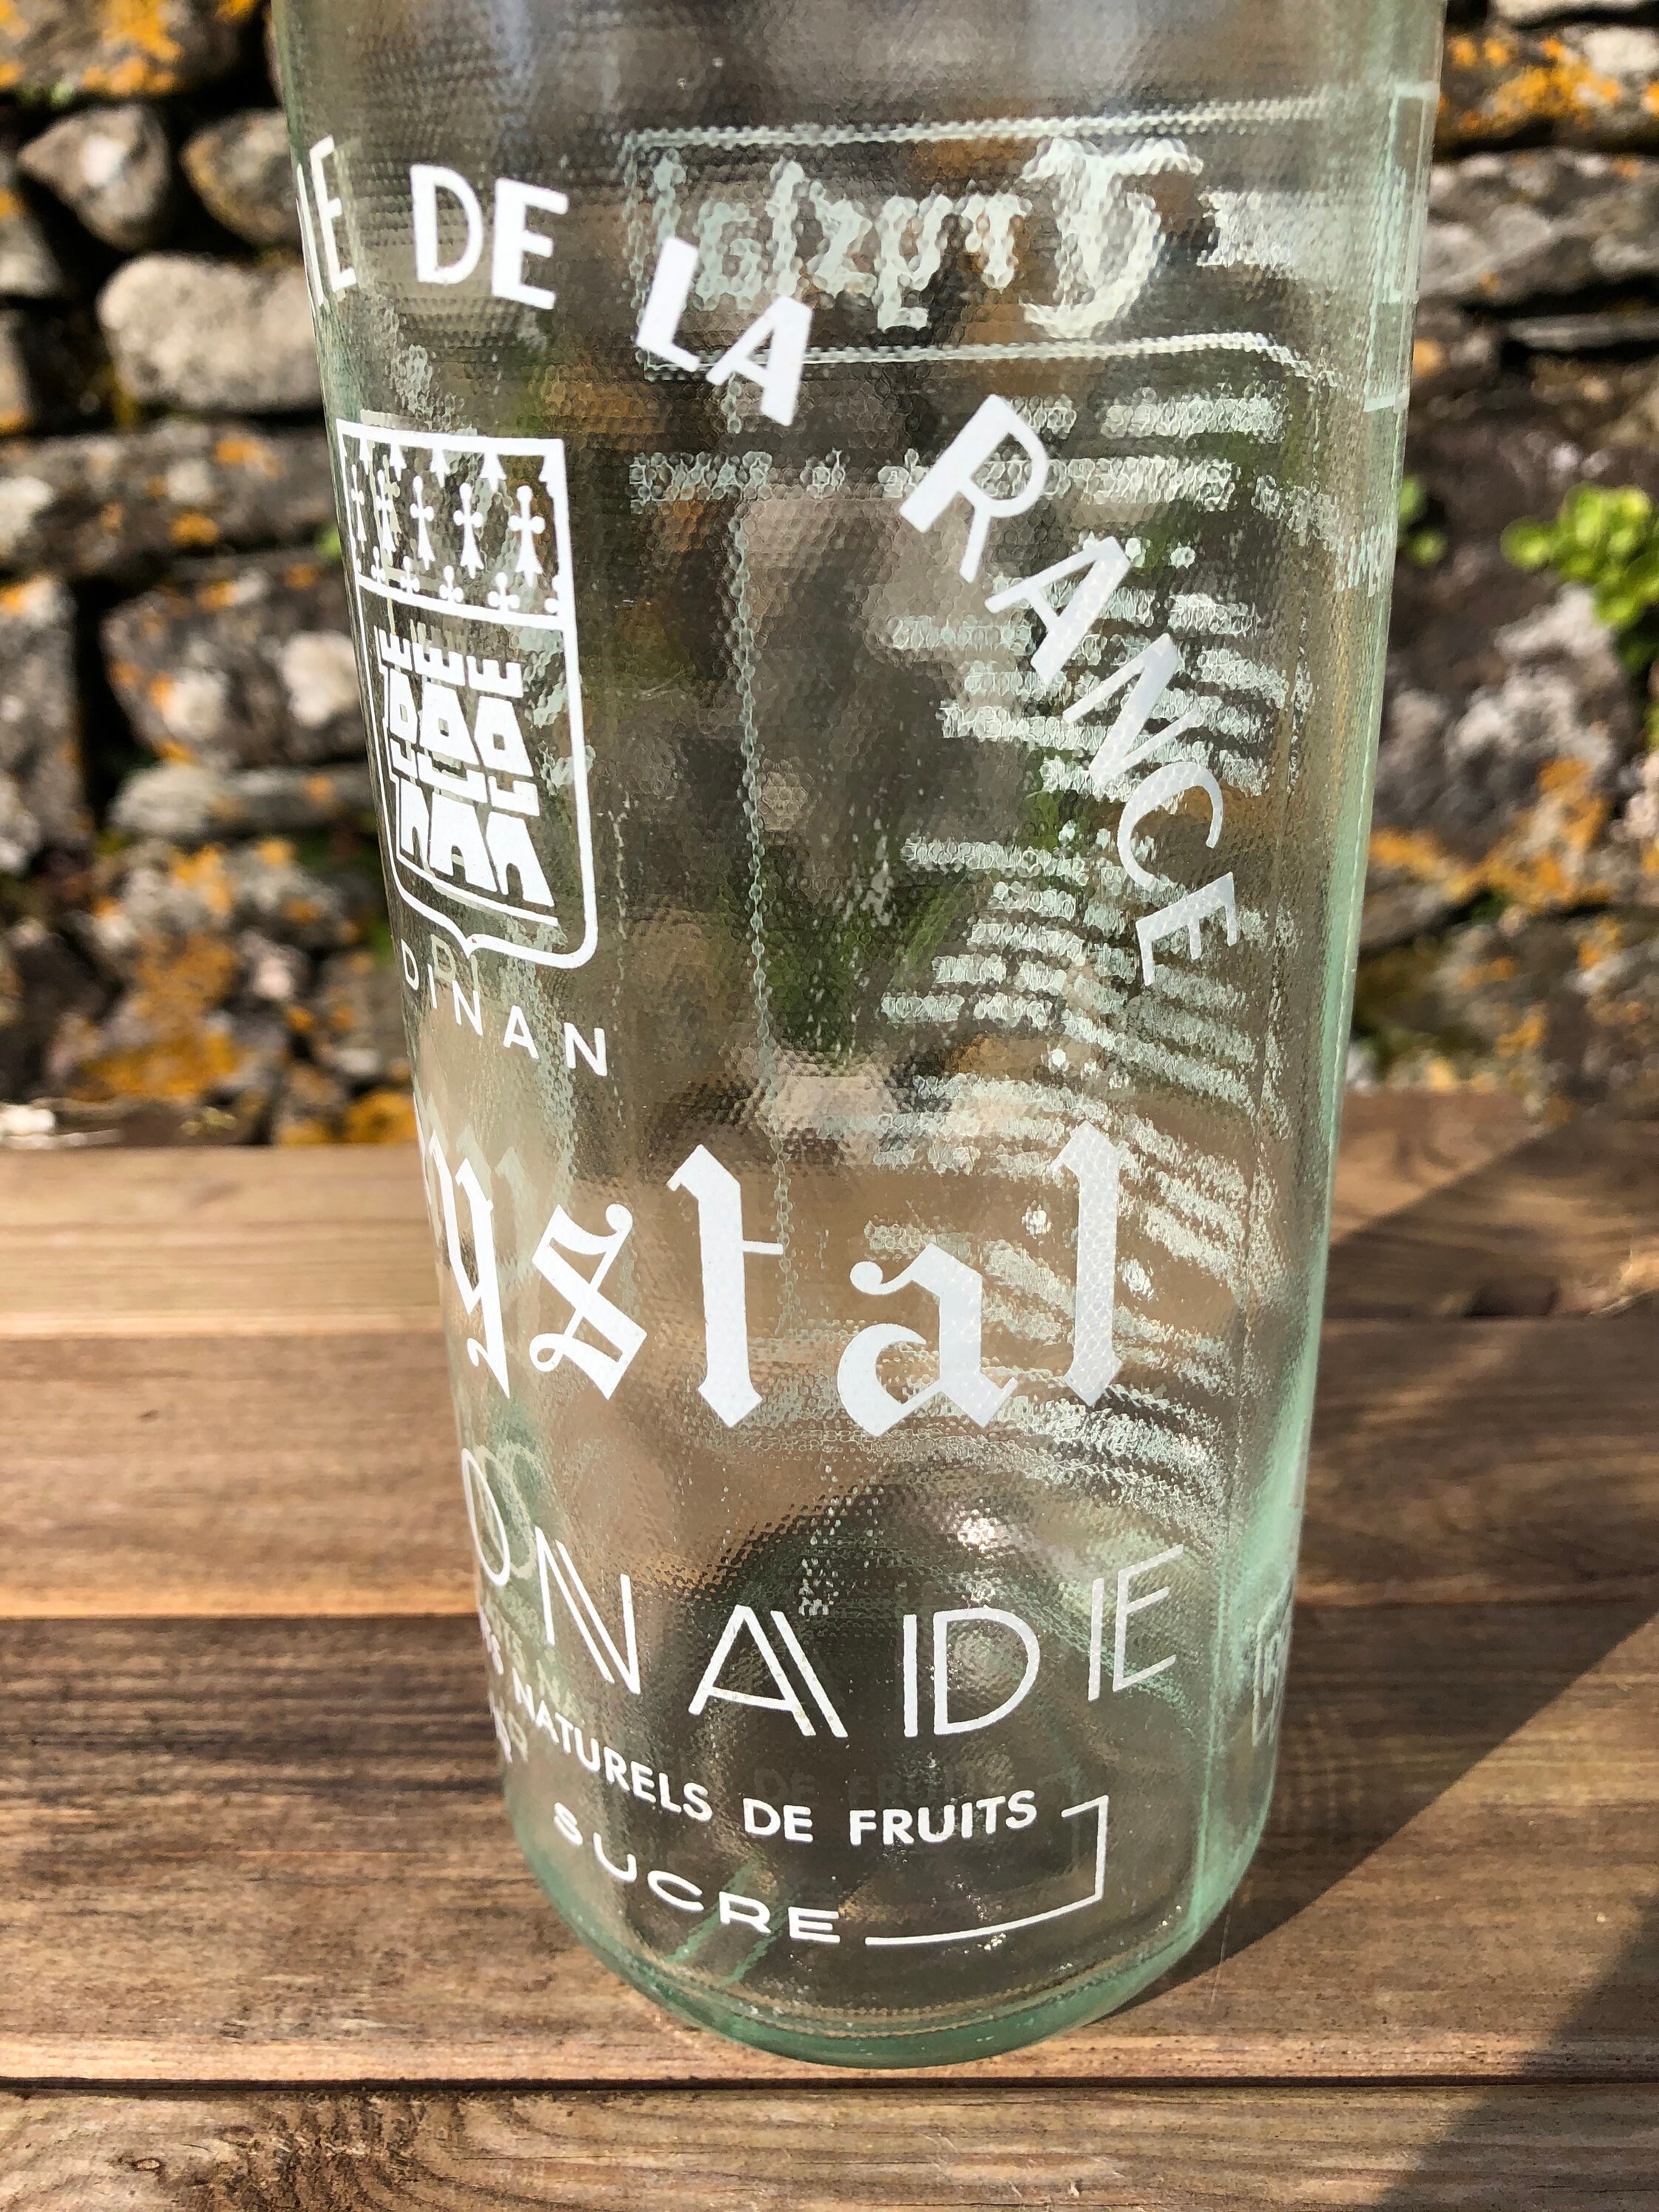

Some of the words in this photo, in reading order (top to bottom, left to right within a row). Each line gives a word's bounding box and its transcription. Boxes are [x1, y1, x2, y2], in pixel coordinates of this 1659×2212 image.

[410, 165, 569, 311] DE
[635, 235, 812, 427] LA
[899, 394, 1238, 987] RANCE
[400, 939, 608, 1077] DINAN
[415, 1121, 1124, 1437] ystal
[461, 1447, 1184, 1738] ONADE
[512, 1666, 713, 1822] NATURELS
[742, 1797, 814, 1843] DE
[849, 1789, 1038, 1846] FRUITS
[554, 1802, 841, 1944] SUCRE
